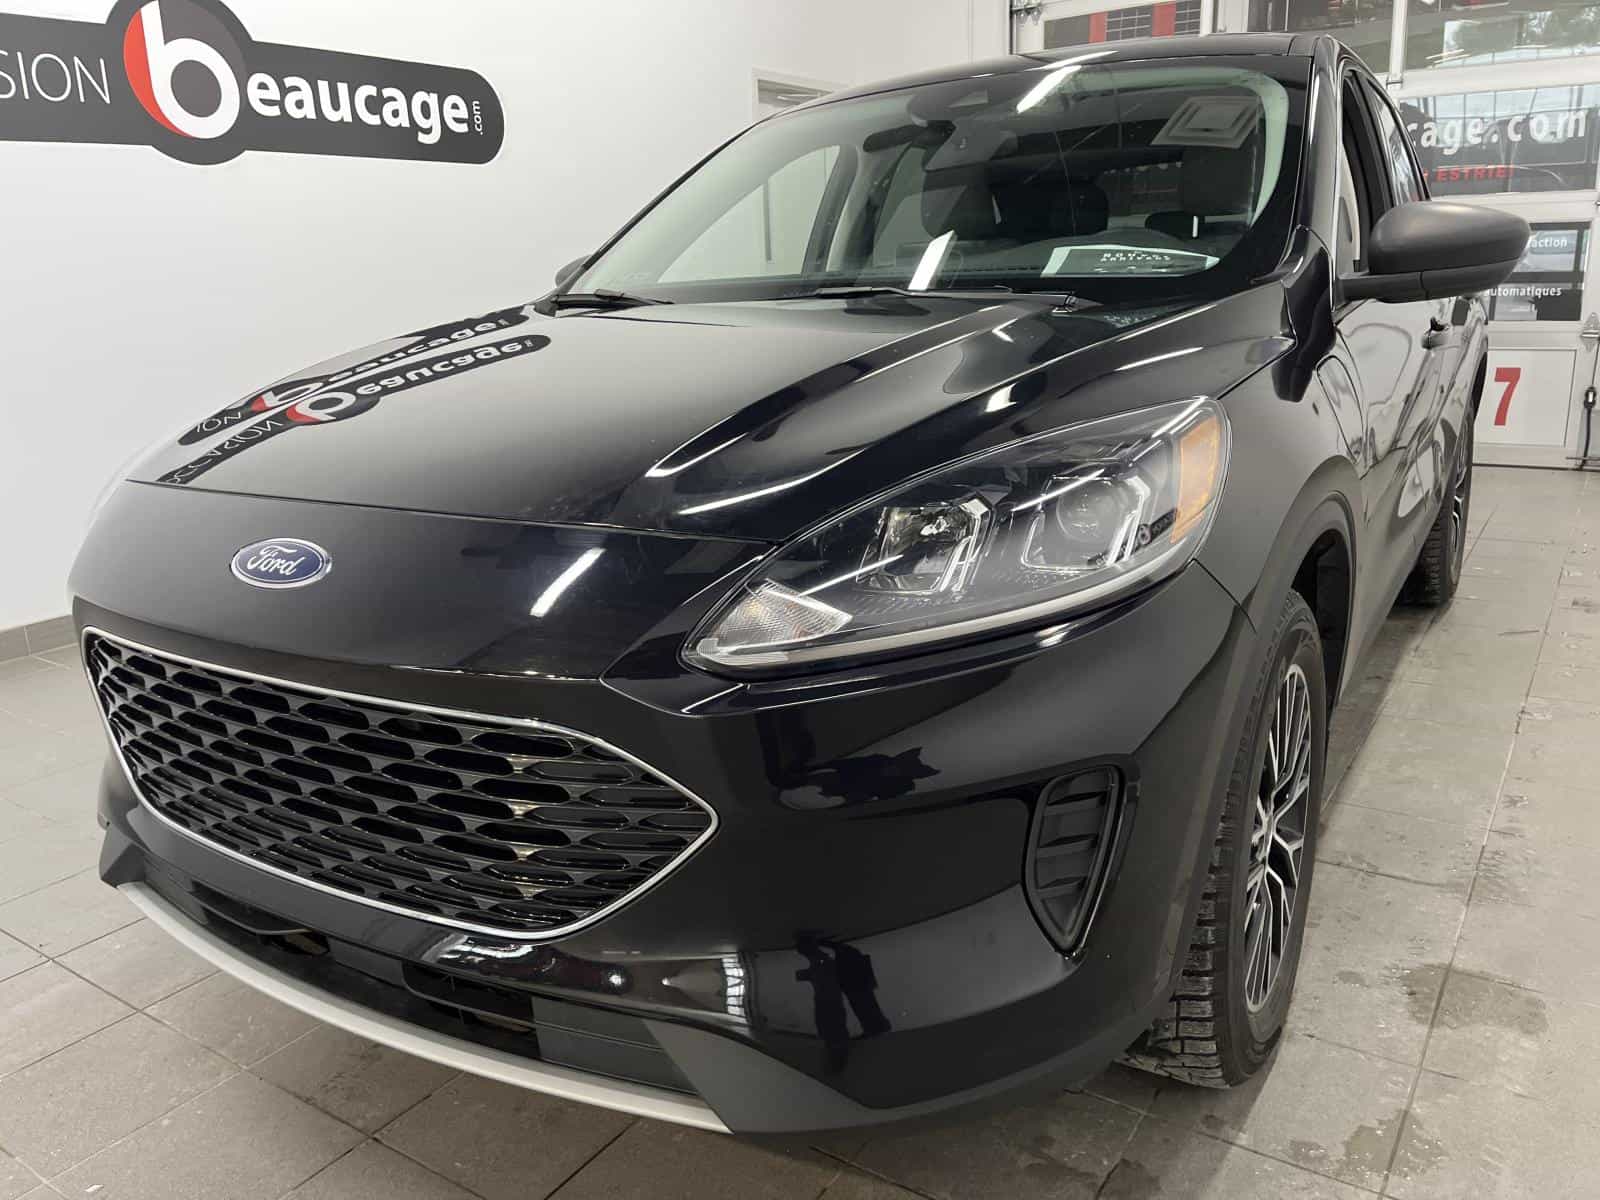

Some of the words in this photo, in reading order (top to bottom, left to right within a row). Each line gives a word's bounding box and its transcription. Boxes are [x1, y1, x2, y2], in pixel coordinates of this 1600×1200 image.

[0, 49, 111, 104] SION
[1494, 367, 1521, 426] 7
[246, 544, 306, 576] Ford
